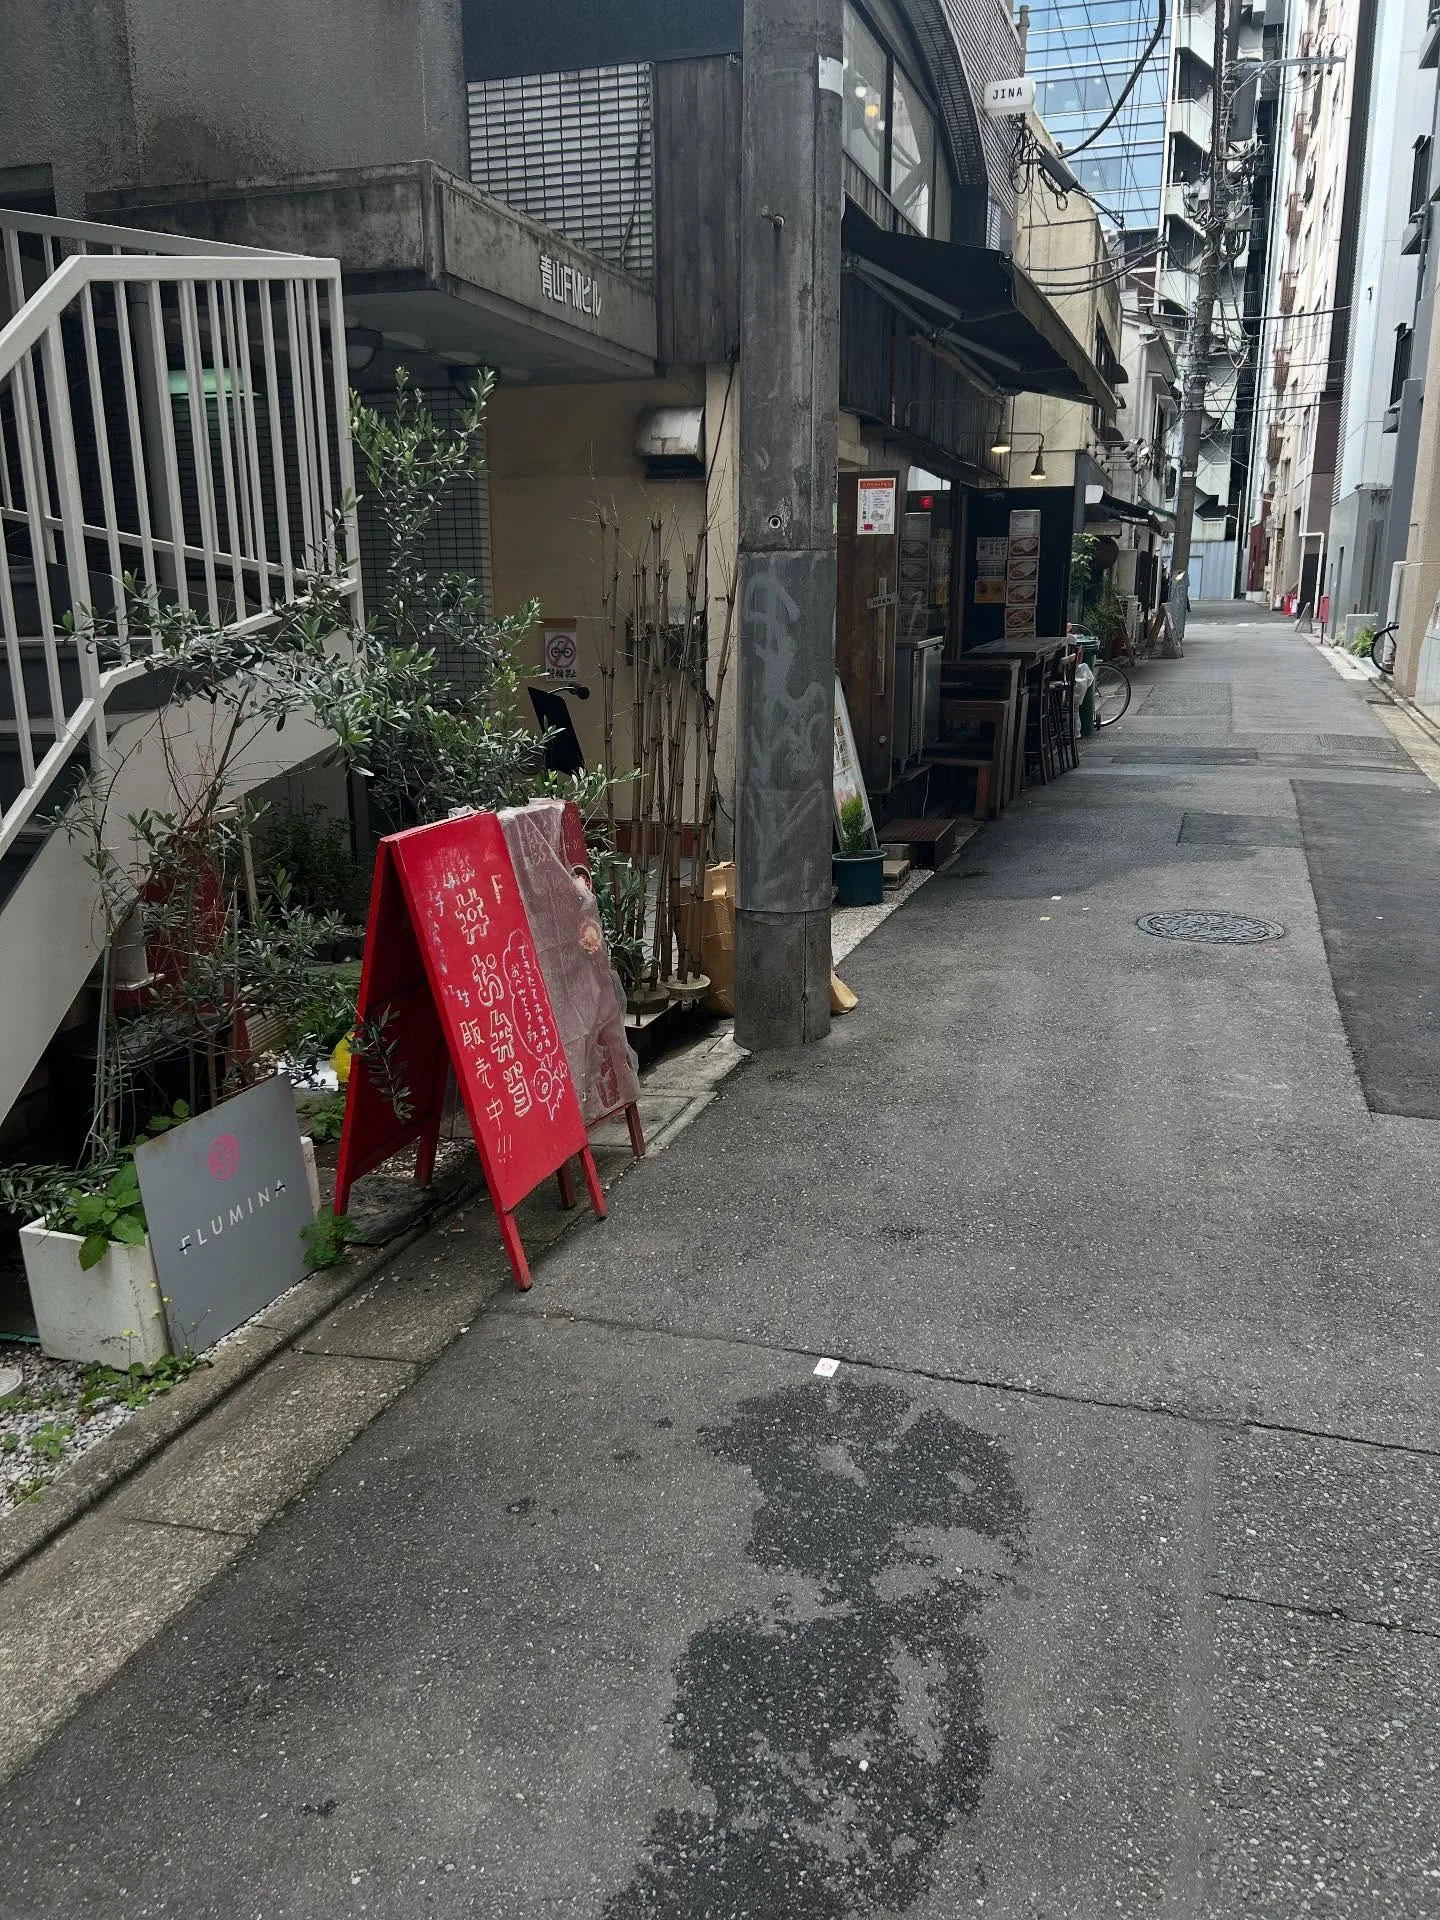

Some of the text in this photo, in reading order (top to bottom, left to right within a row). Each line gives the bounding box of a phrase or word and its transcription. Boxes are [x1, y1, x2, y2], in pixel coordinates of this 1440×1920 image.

[993, 87, 1022, 99] JINA
[540, 254, 602, 317] 青山FMビル
[178, 1179, 287, 1256] FLUMINA
